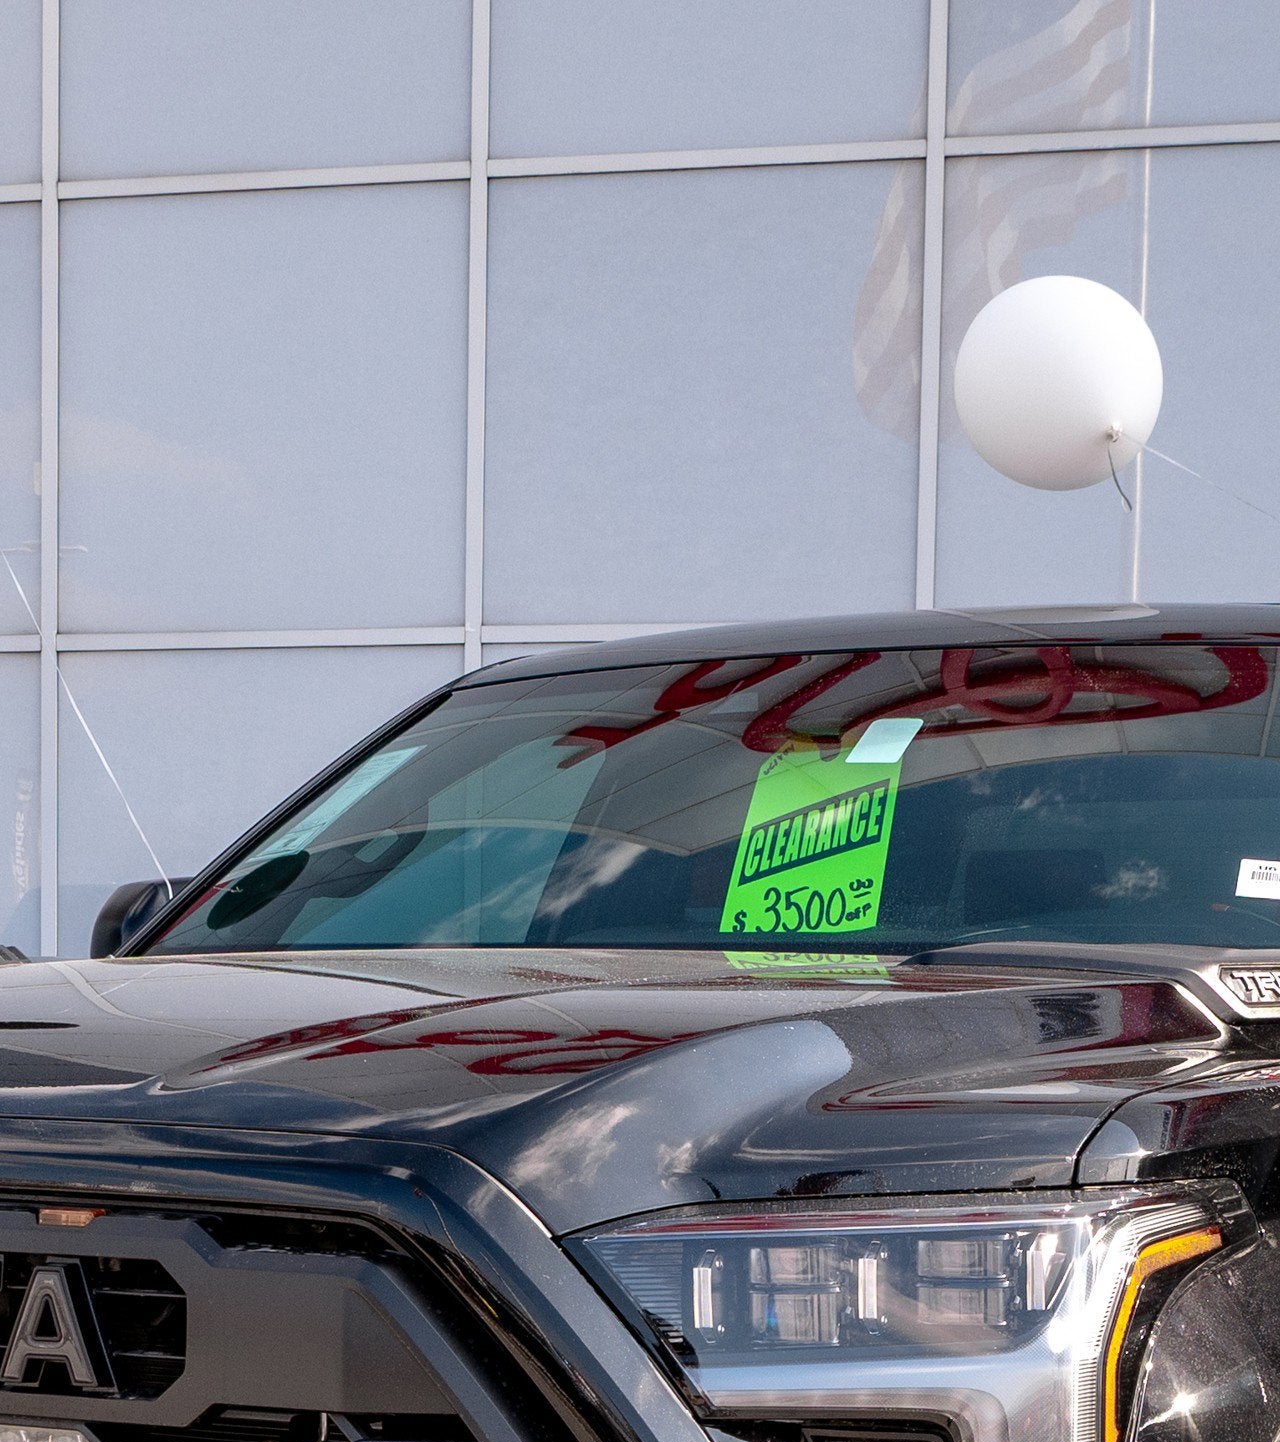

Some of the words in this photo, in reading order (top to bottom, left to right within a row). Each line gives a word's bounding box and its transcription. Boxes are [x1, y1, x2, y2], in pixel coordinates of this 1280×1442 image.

[744, 786, 886, 877] CLEARANCE
[732, 909, 748, 933] $
[755, 886, 847, 933] 3500
